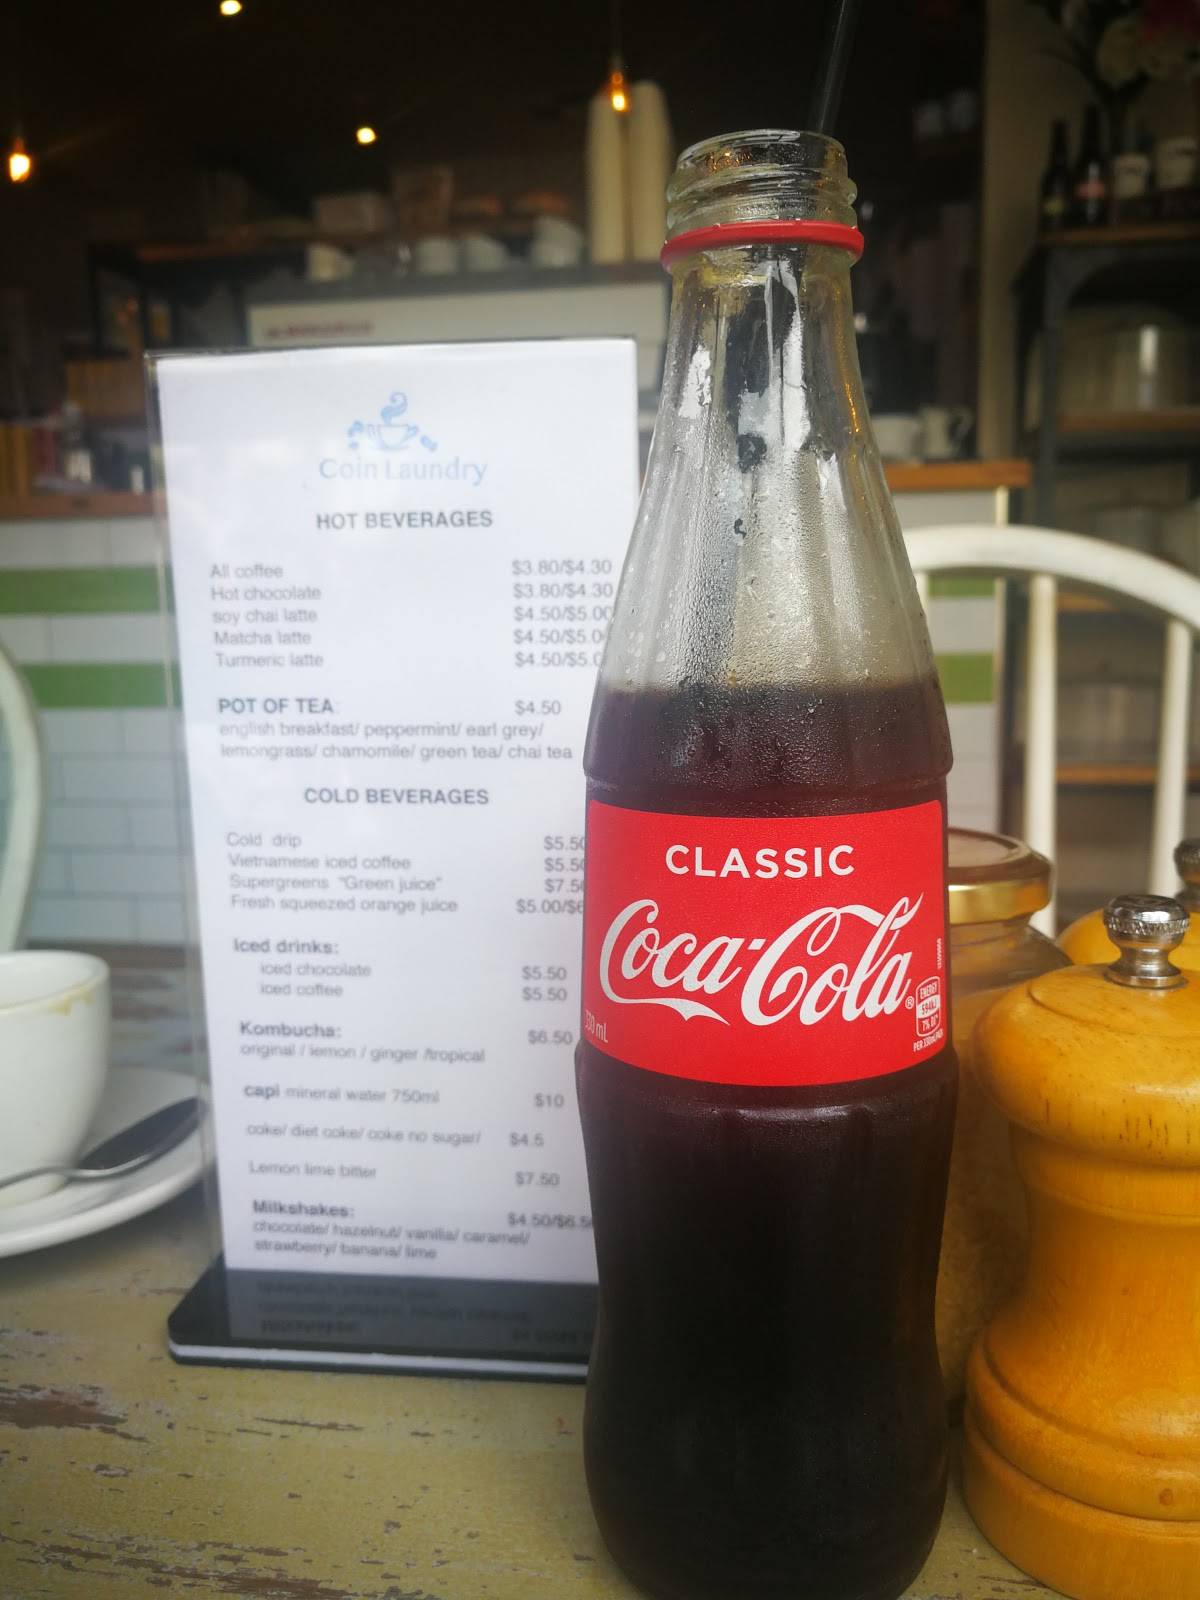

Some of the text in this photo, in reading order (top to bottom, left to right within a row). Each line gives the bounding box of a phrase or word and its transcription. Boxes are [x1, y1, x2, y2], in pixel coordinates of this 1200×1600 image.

[319, 456, 488, 486] Coin Laundry
[316, 511, 493, 531] HOT BEVERAGES
[211, 563, 283, 579] All coffee
[512, 560, 612, 577] $3.80/$4.30
[211, 585, 321, 601] Hot chocolate
[513, 583, 613, 599] $3.80/$4.30
[213, 608, 317, 626] soy chai latte
[214, 631, 311, 645] Matcha latte
[215, 653, 323, 668] Turmeric latte
[219, 699, 256, 715] POT
[263, 699, 289, 714] OF
[515, 700, 561, 717] $4.50
[220, 721, 543, 741] english breakfast/ peppermint/ earl grey/
[221, 744, 572, 763] lemongrass/ chamomile/ green tea/ chai tea
[304, 789, 489, 804] COLD BEVERAGES
[226, 832, 301, 851] Cold drip
[228, 854, 410, 870] Vietnamese iced coffee
[665, 845, 855, 879] CLASSIC
[230, 875, 442, 893] Supergreens "Green juice"
[231, 895, 458, 915] Fresh squeezed orange juice
[234, 939, 339, 954] Iced drinks:
[600, 891, 924, 1026] Coca-Cola
[261, 963, 371, 977] iced chocolate
[522, 966, 566, 981] $5.50
[261, 983, 343, 997] iced coffee
[522, 987, 567, 1002] $5.50
[240, 1021, 341, 1038] Kombucha:
[528, 1030, 572, 1045] $6.50
[241, 1044, 295, 1059] original
[310, 1045, 356, 1059] lemon
[371, 1047, 418, 1063] ginger
[423, 1048, 485, 1064] /tropical
[245, 1084, 440, 1104] capi mineral water 750ml
[534, 1094, 564, 1108] $10
[247, 1124, 481, 1146] coke/ diet coke/ coke no sugar/
[509, 1133, 543, 1147] $4.5
[249, 1162, 376, 1179] Lemon lime bitter
[515, 1171, 560, 1187] $7.50
[253, 1200, 354, 1218] Milkshakes:
[253, 1221, 529, 1246] chocolate/ hazelnut/ vanilla/ caramel/
[254, 1239, 437, 1259] strawberry/ banana/ lime
